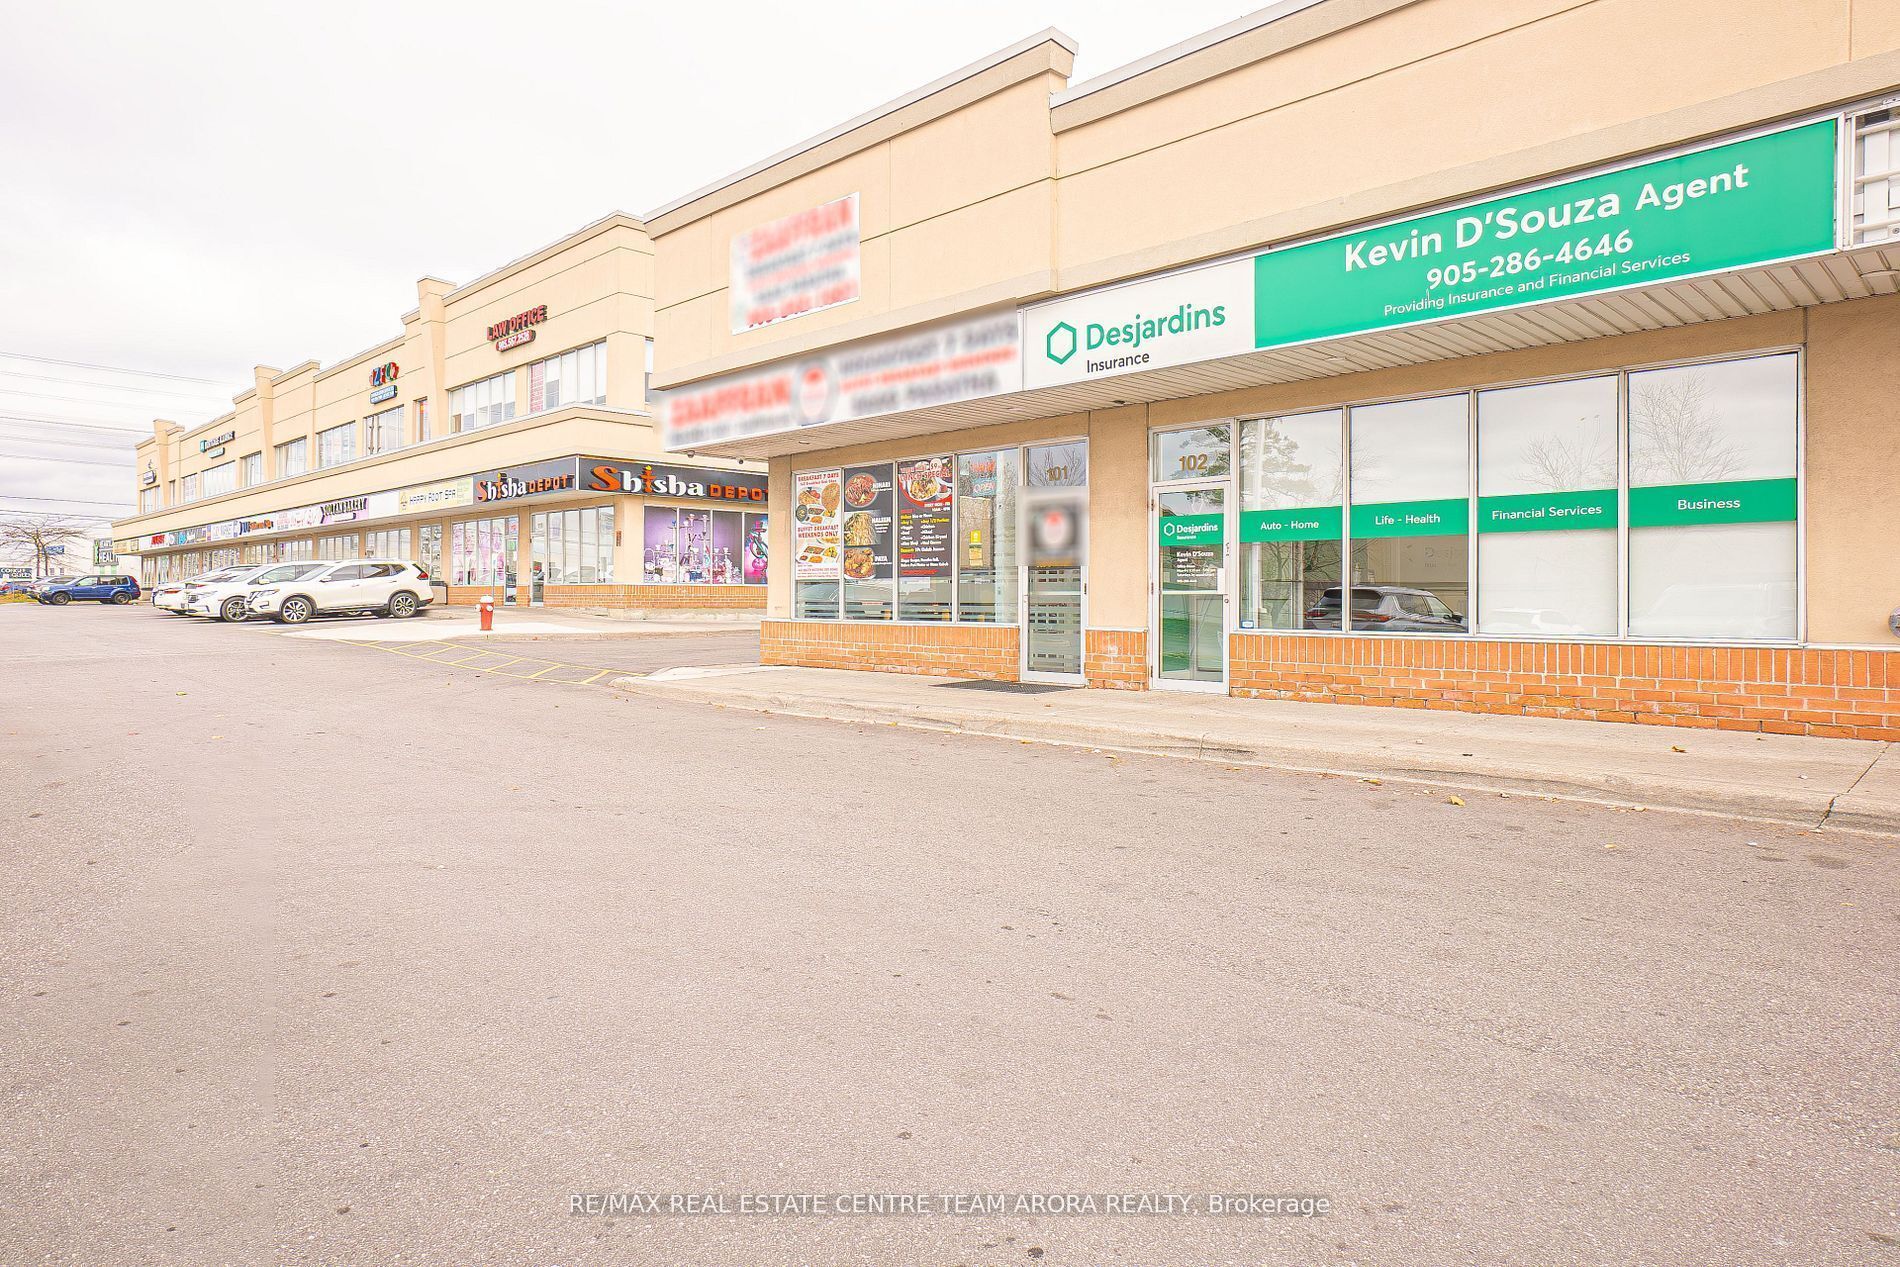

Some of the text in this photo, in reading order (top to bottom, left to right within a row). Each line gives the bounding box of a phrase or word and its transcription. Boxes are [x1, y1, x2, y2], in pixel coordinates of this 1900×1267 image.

[1344, 163, 1750, 272] Kevin D'Souza Agent
[1426, 229, 1635, 291] 905-286-4646
[1383, 251, 1691, 317] Providing Insurance and Financial Services
[487, 305, 547, 341] LAW OFFICE
[1086, 303, 1226, 350] Desjardins
[1086, 353, 1150, 373] Insurance
[1178, 453, 1208, 471] 102
[591, 465, 706, 496] Shisha
[798, 474, 822, 482] BREAKFAST
[1046, 465, 1069, 482] 101
[476, 472, 527, 502] Shisha
[528, 472, 569, 493] DEPOT
[410, 495, 426, 504] HAPPY
[428, 492, 443, 502] FOOT
[444, 489, 456, 500] SPA
[1677, 497, 1741, 511] Business
[1375, 514, 1395, 526] Life
[1405, 513, 1441, 525] Health
[1491, 504, 1603, 520] Financial Services
[1176, 523, 1219, 535] Desjardins
[1260, 521, 1282, 531] Auto
[1290, 520, 1320, 530] Home
